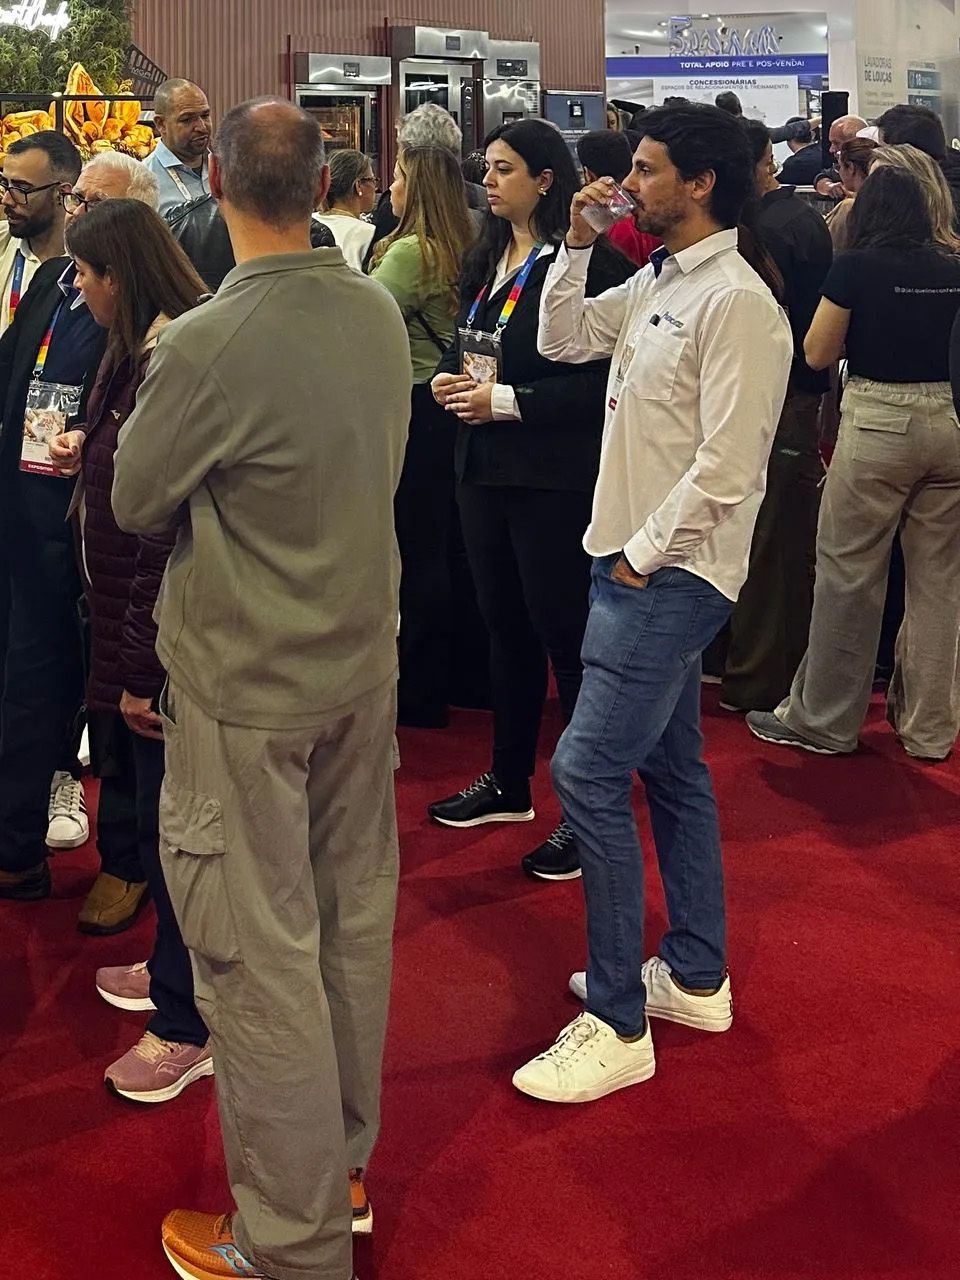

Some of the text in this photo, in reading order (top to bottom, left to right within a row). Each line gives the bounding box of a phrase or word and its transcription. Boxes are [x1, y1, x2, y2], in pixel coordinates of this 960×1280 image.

[680, 61, 704, 69] TOTAL
[864, 70, 872, 82] DE
[689, 78, 757, 86] CONCESSIONÁRIAS
